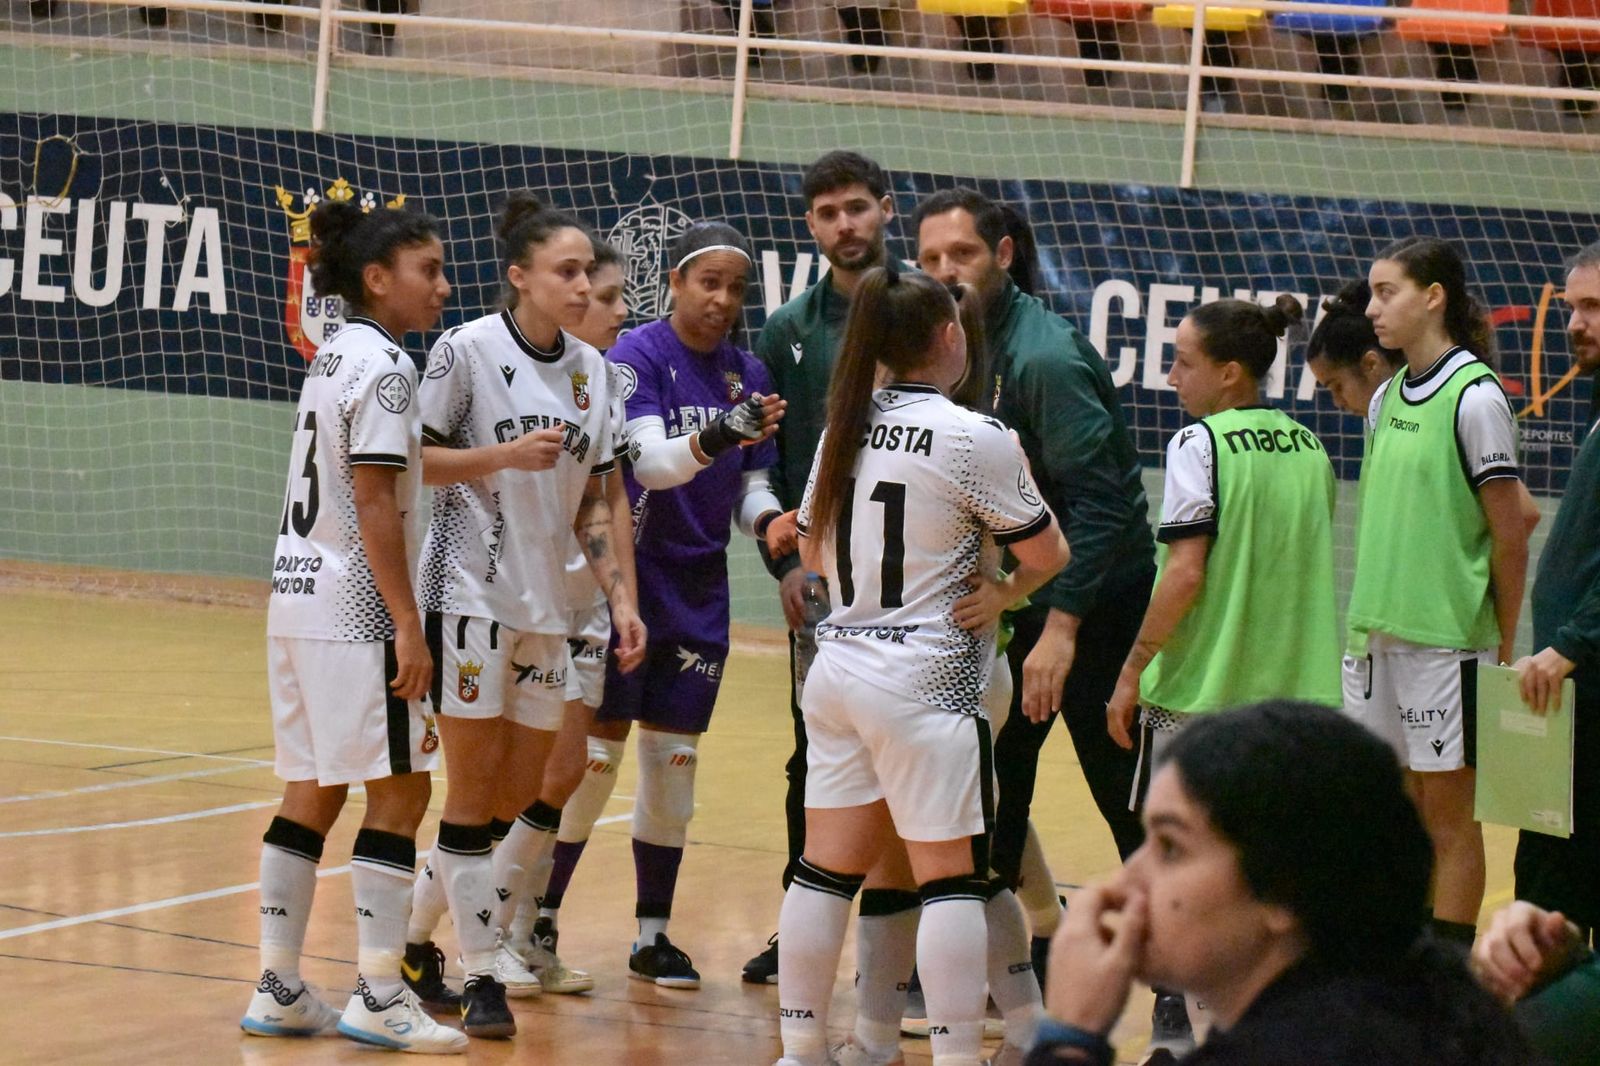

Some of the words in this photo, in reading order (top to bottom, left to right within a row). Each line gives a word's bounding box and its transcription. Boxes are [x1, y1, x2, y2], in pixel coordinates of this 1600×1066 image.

[1089, 279, 1338, 401] CET
[1400, 707, 1448, 723] HÉLITY
[779, 1008, 815, 1019] EUTA
